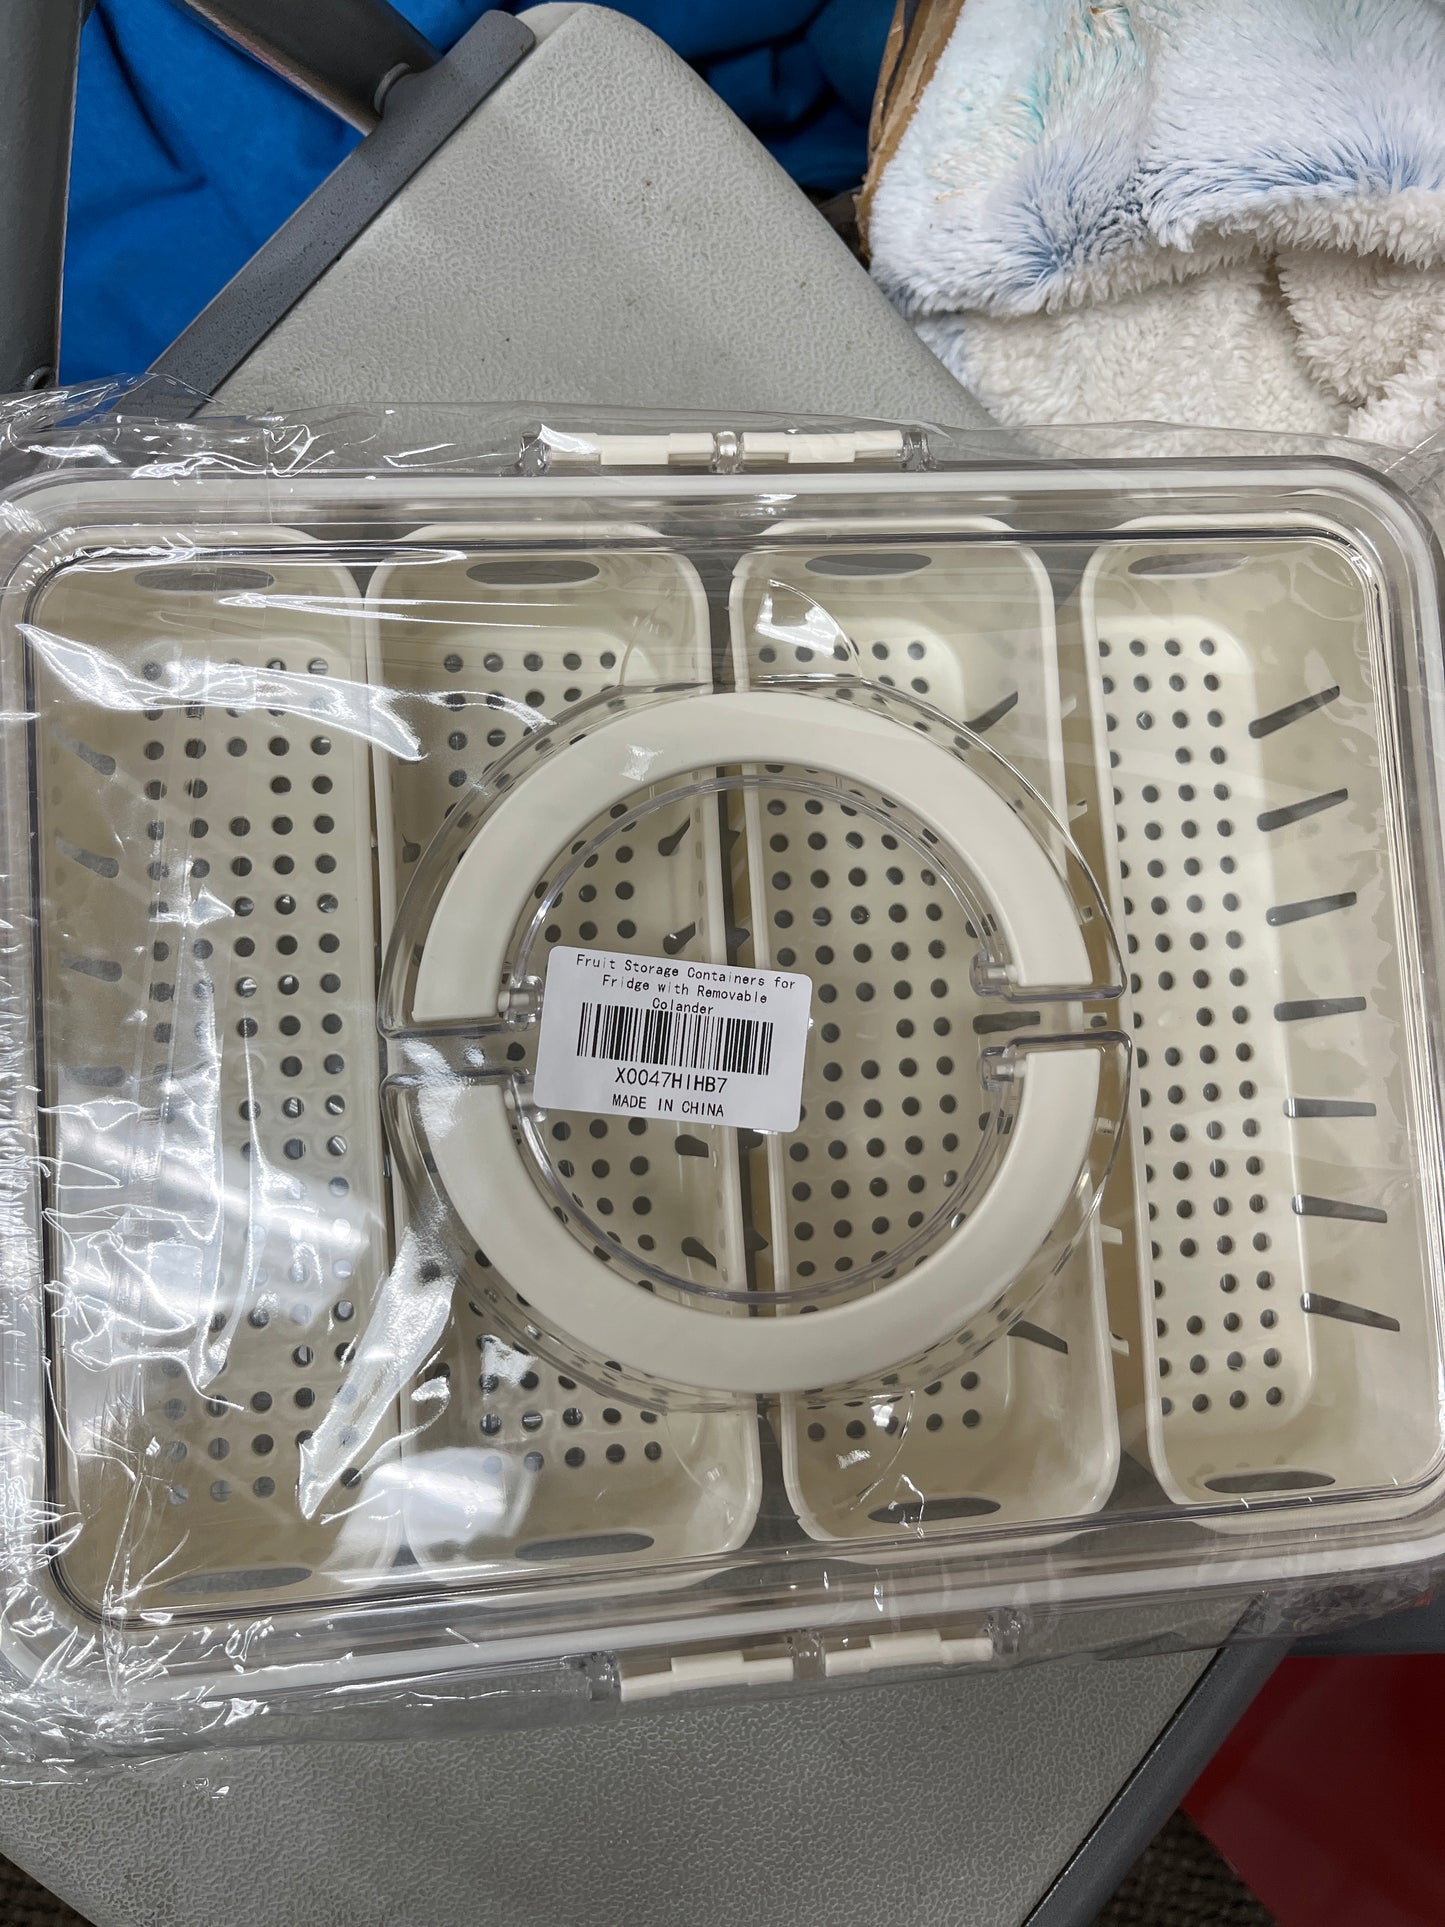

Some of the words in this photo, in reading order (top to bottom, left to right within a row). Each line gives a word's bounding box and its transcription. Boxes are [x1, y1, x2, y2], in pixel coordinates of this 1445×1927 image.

[576, 954, 615, 969] Fruit
[625, 960, 679, 977] Storage
[688, 967, 765, 986] Containers
[774, 977, 796, 989] for
[603, 975, 649, 991] Fridge
[658, 981, 688, 995] with
[697, 985, 767, 1003] Removable
[652, 998, 714, 1014] Colander
[615, 1067, 728, 1093] X0047HIHB7
[612, 1094, 646, 1109] MADE
[658, 1098, 673, 1111] IN
[682, 1101, 724, 1117] CHINA
